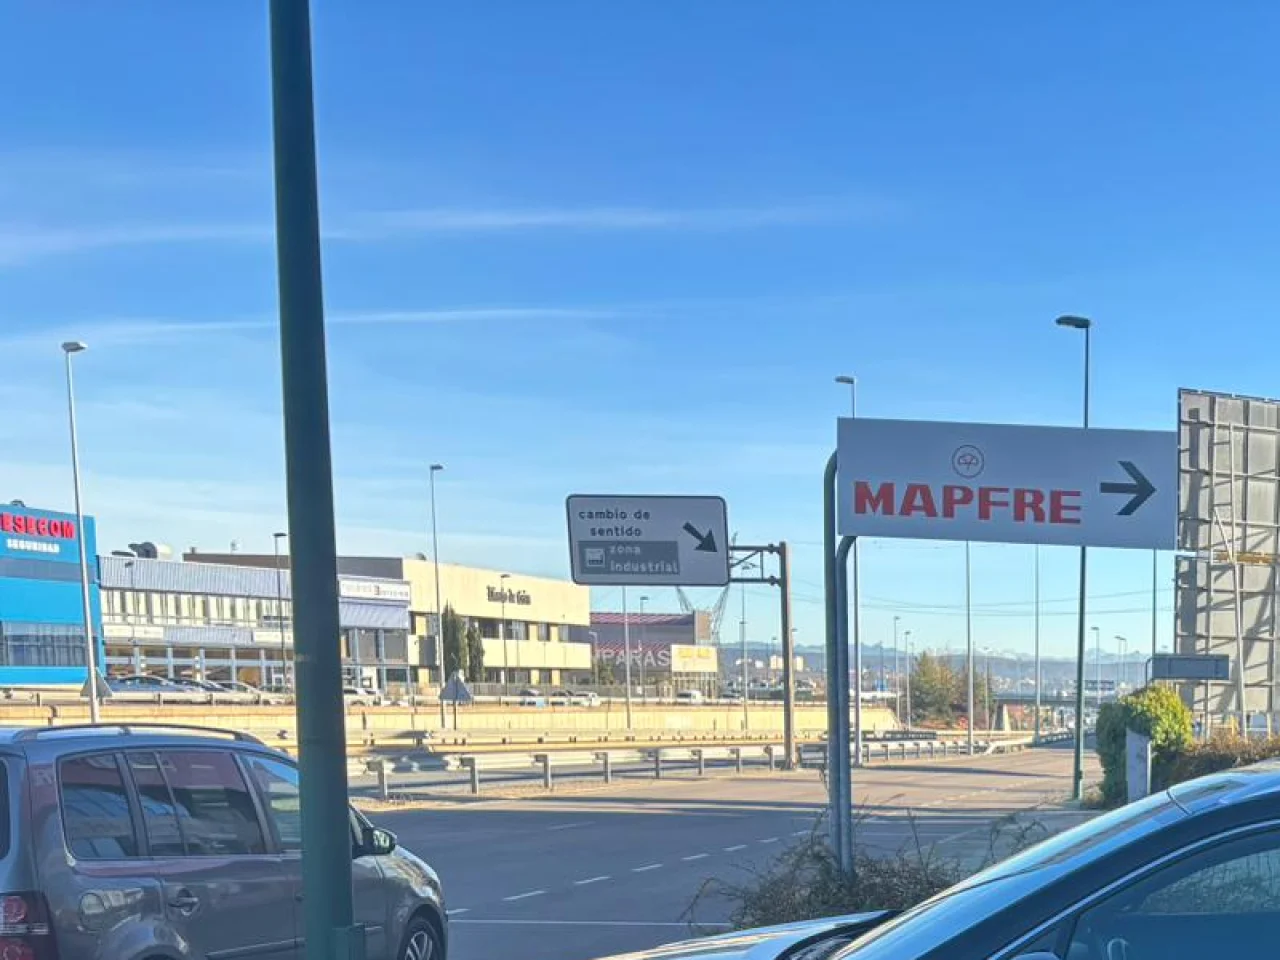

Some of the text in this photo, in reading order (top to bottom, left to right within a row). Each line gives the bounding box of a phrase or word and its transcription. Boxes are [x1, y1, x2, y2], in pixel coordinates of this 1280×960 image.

[853, 480, 1082, 525] MAPFRE
[578, 508, 650, 520] cambio de
[590, 526, 642, 537] sentido
[610, 544, 641, 556] zona
[610, 560, 679, 573] industrial
